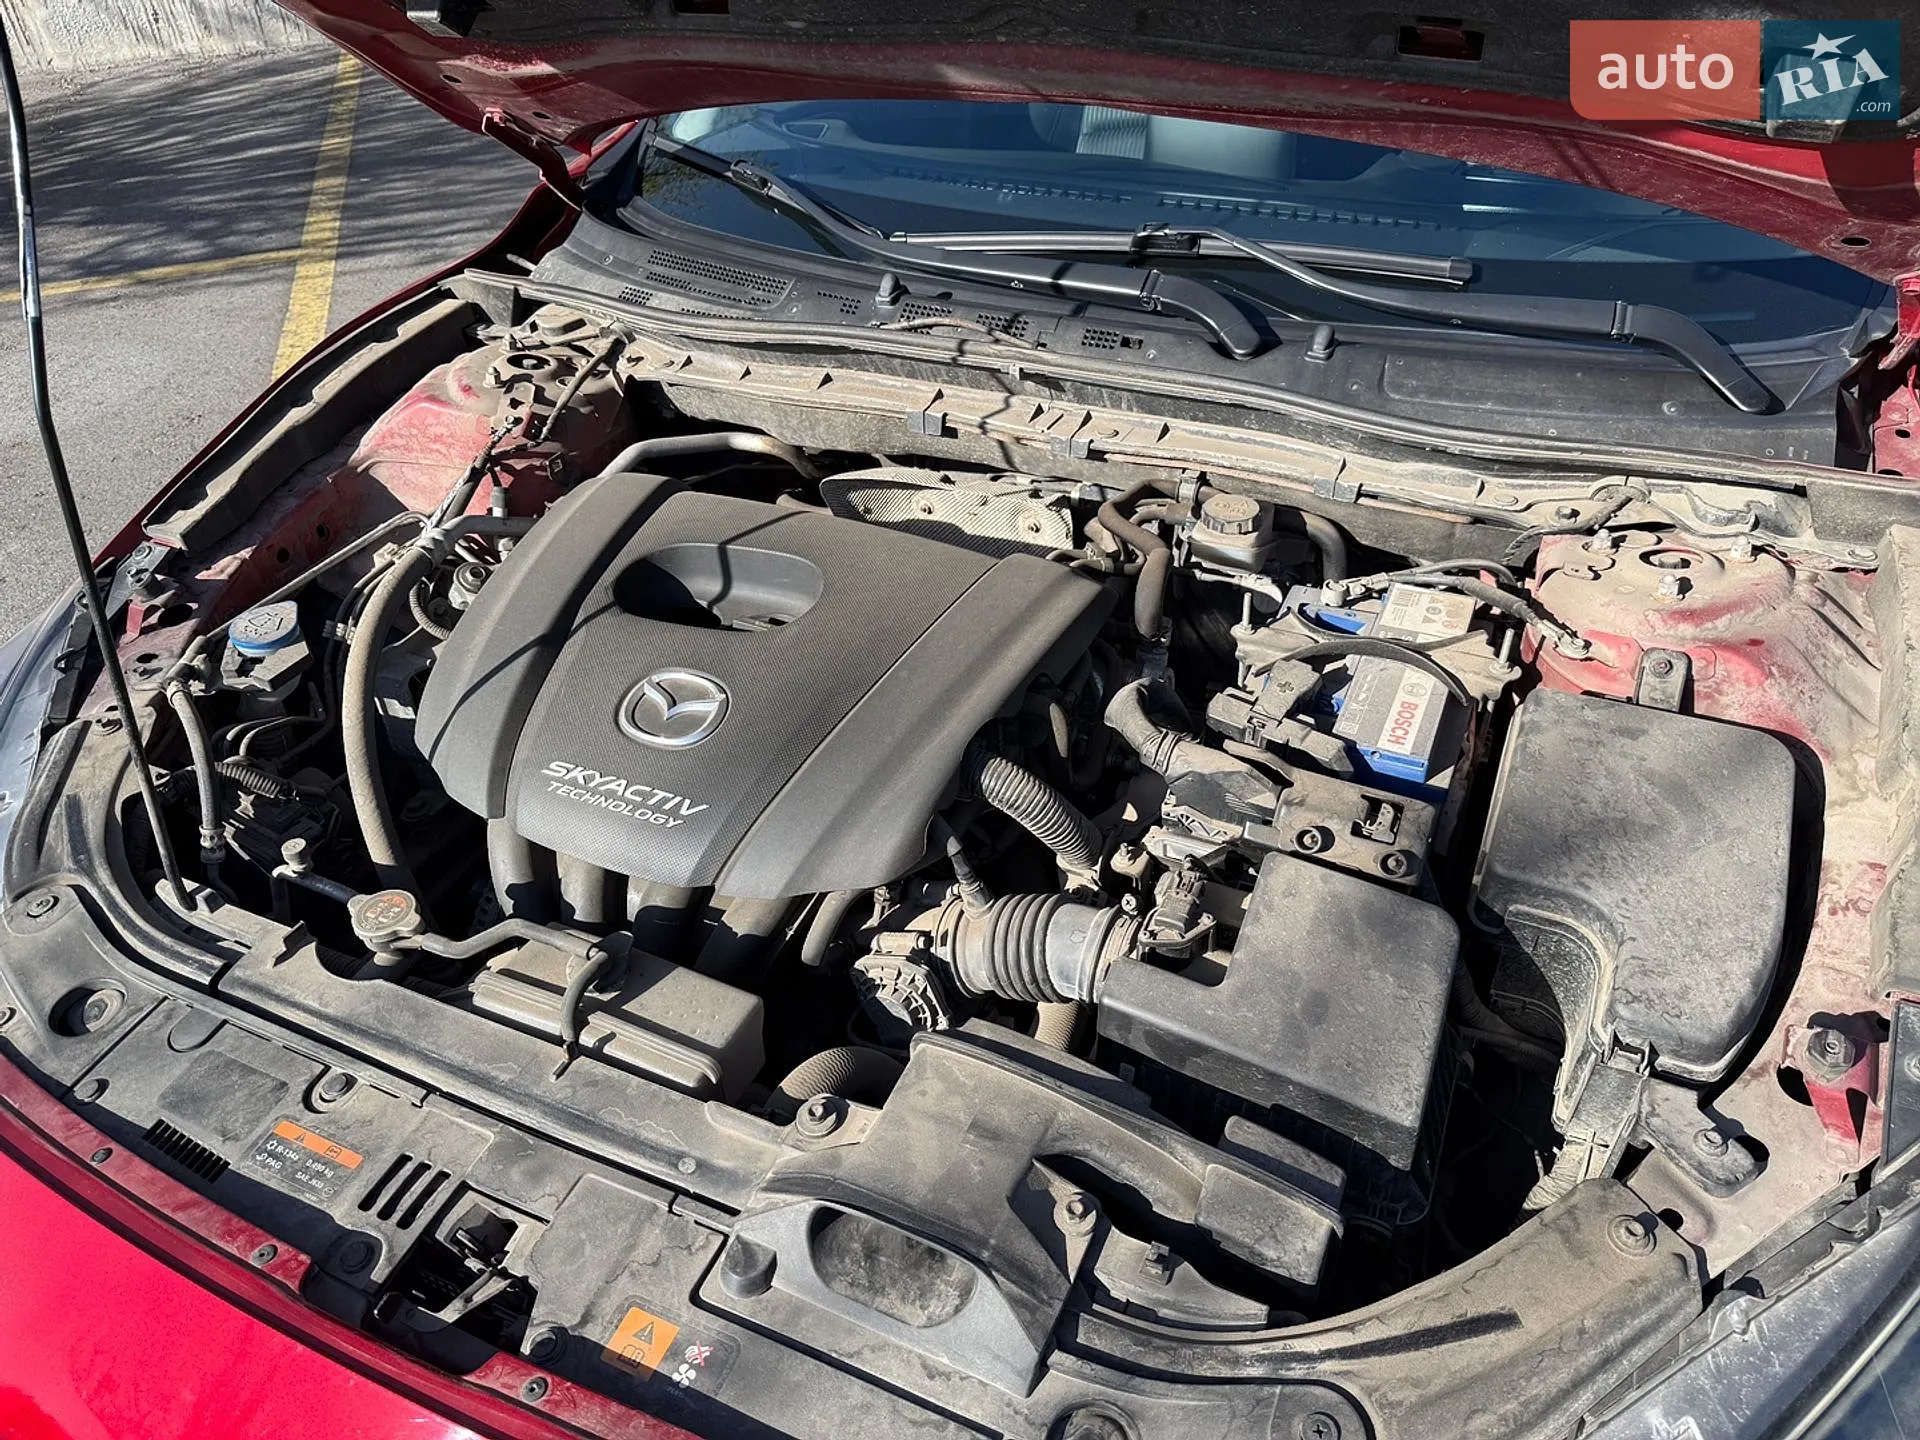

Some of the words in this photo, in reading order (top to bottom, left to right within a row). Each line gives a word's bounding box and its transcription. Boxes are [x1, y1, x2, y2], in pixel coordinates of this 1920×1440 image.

[1387, 700, 1419, 746] BOSCH
[541, 761, 711, 816] SKYACTIV
[547, 781, 685, 828] TECHNOLOGY
[265, 1157, 283, 1169] PAG
